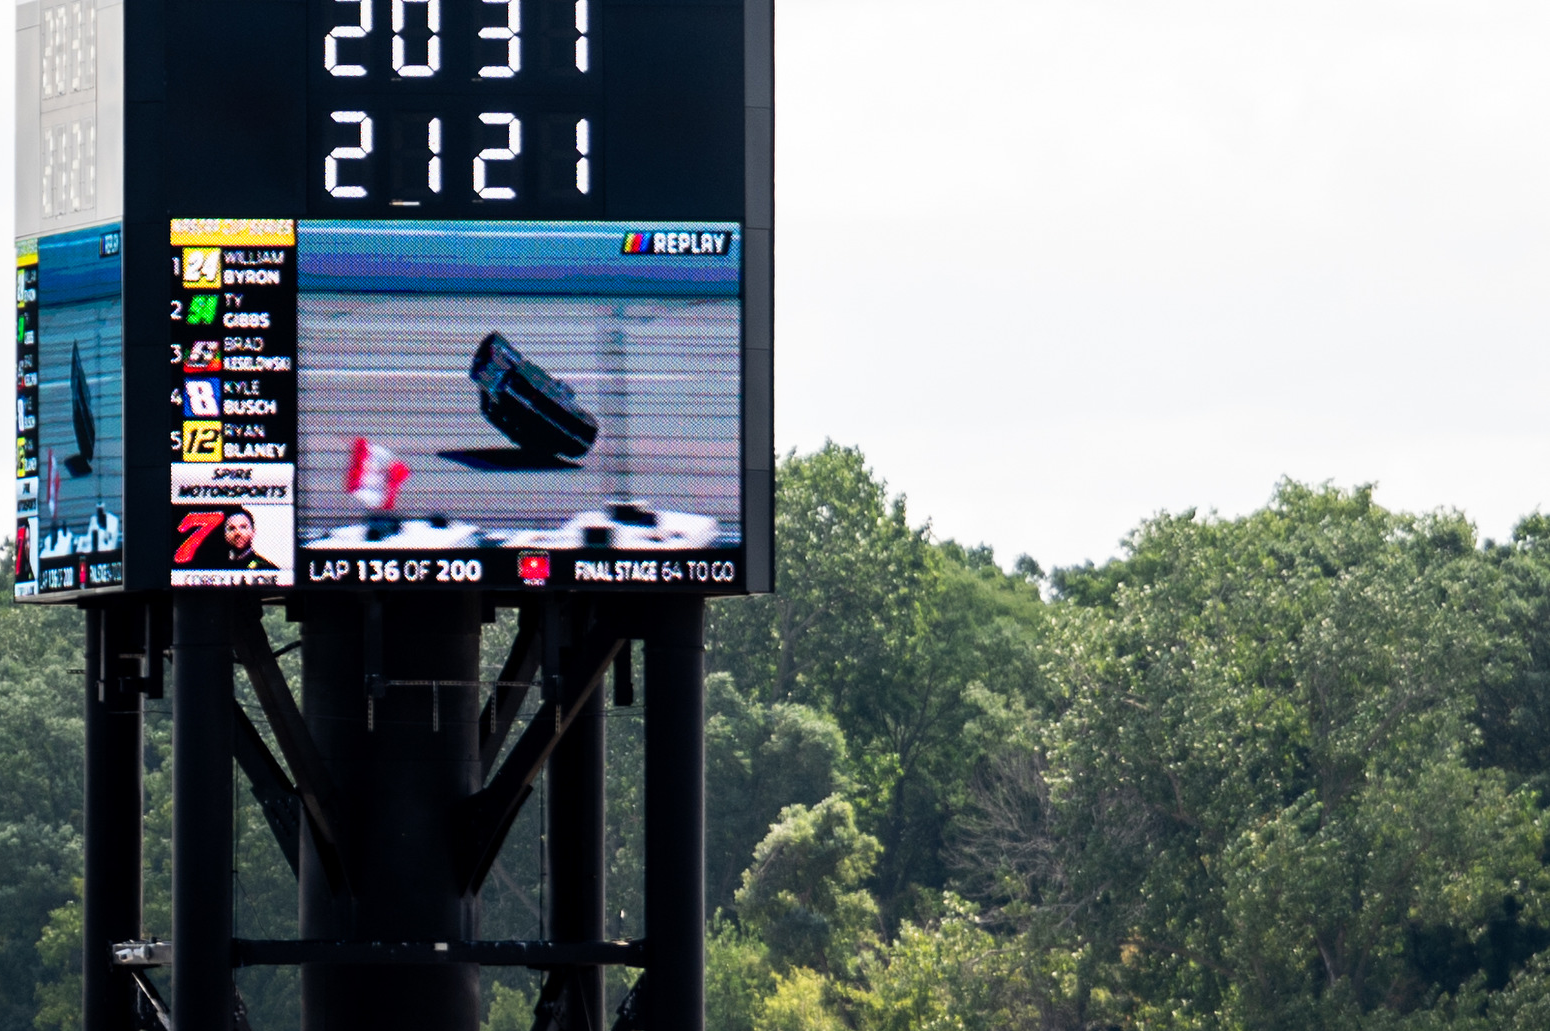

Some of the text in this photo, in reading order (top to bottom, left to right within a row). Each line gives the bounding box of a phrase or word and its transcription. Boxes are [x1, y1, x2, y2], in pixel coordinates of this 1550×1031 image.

[653, 232, 726, 254] REPLAY
[223, 250, 285, 265] WILLIAM
[183, 251, 220, 283] 24
[223, 270, 280, 284] BYRON
[224, 293, 243, 308] TY
[170, 300, 183, 320] 2
[223, 312, 271, 328] GIBBS
[224, 337, 264, 352] BRAD
[170, 344, 182, 364] 3
[224, 380, 259, 395] KYLE
[186, 380, 220, 416] 8
[223, 399, 276, 415] BUSCH
[224, 423, 265, 438] RYAN
[170, 430, 182, 450] 5
[187, 429, 221, 454] 12
[223, 443, 286, 458] BLANEY
[212, 468, 252, 480] SPIRE
[179, 485, 287, 498] MOTORSPORTS
[174, 511, 225, 563] 7
[309, 560, 482, 582] LAP 136 OF 200
[575, 560, 735, 581] FINAL STAGE 64 TO GO
